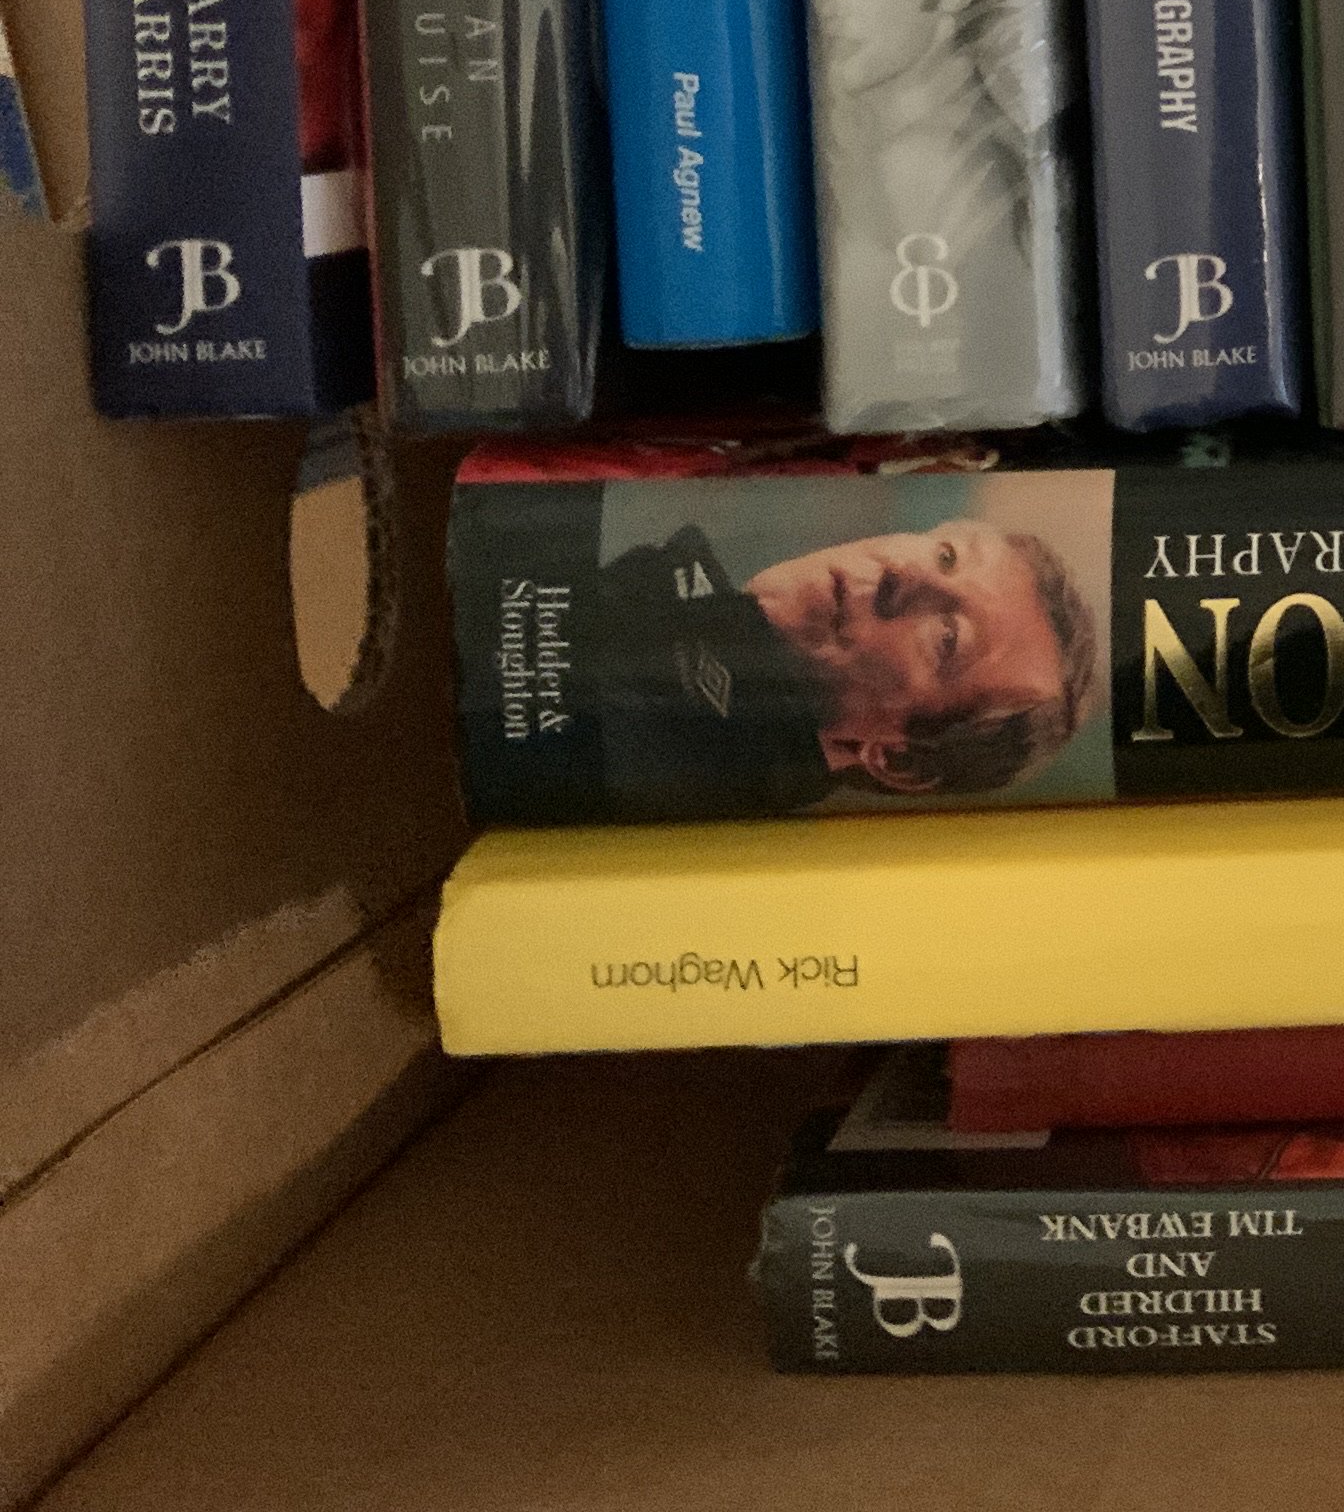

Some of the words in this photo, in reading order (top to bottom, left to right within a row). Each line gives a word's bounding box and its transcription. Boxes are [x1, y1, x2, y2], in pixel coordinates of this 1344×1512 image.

[673, 72, 702, 137] Paul
[673, 145, 704, 252] Agnew
[129, 342, 188, 365] JOHN
[197, 339, 266, 362] BLAKE
[404, 354, 466, 379] JOHN
[476, 350, 550, 374] BLAKE
[1128, 349, 1184, 371] JOHN
[1192, 346, 1257, 367] BLAKE
[499, 578, 528, 740] Stoughton
[778, 955, 858, 988] Rick
[1039, 1211, 1213, 1242] EWBANK
[1229, 1209, 1303, 1236] TIM
[810, 1204, 837, 1281] JOHN
[1126, 1251, 1216, 1278] AND
[1080, 1289, 1264, 1315] HILDRED
[813, 1288, 839, 1361] BLAKE
[1067, 1323, 1277, 1348] STAFFORD
